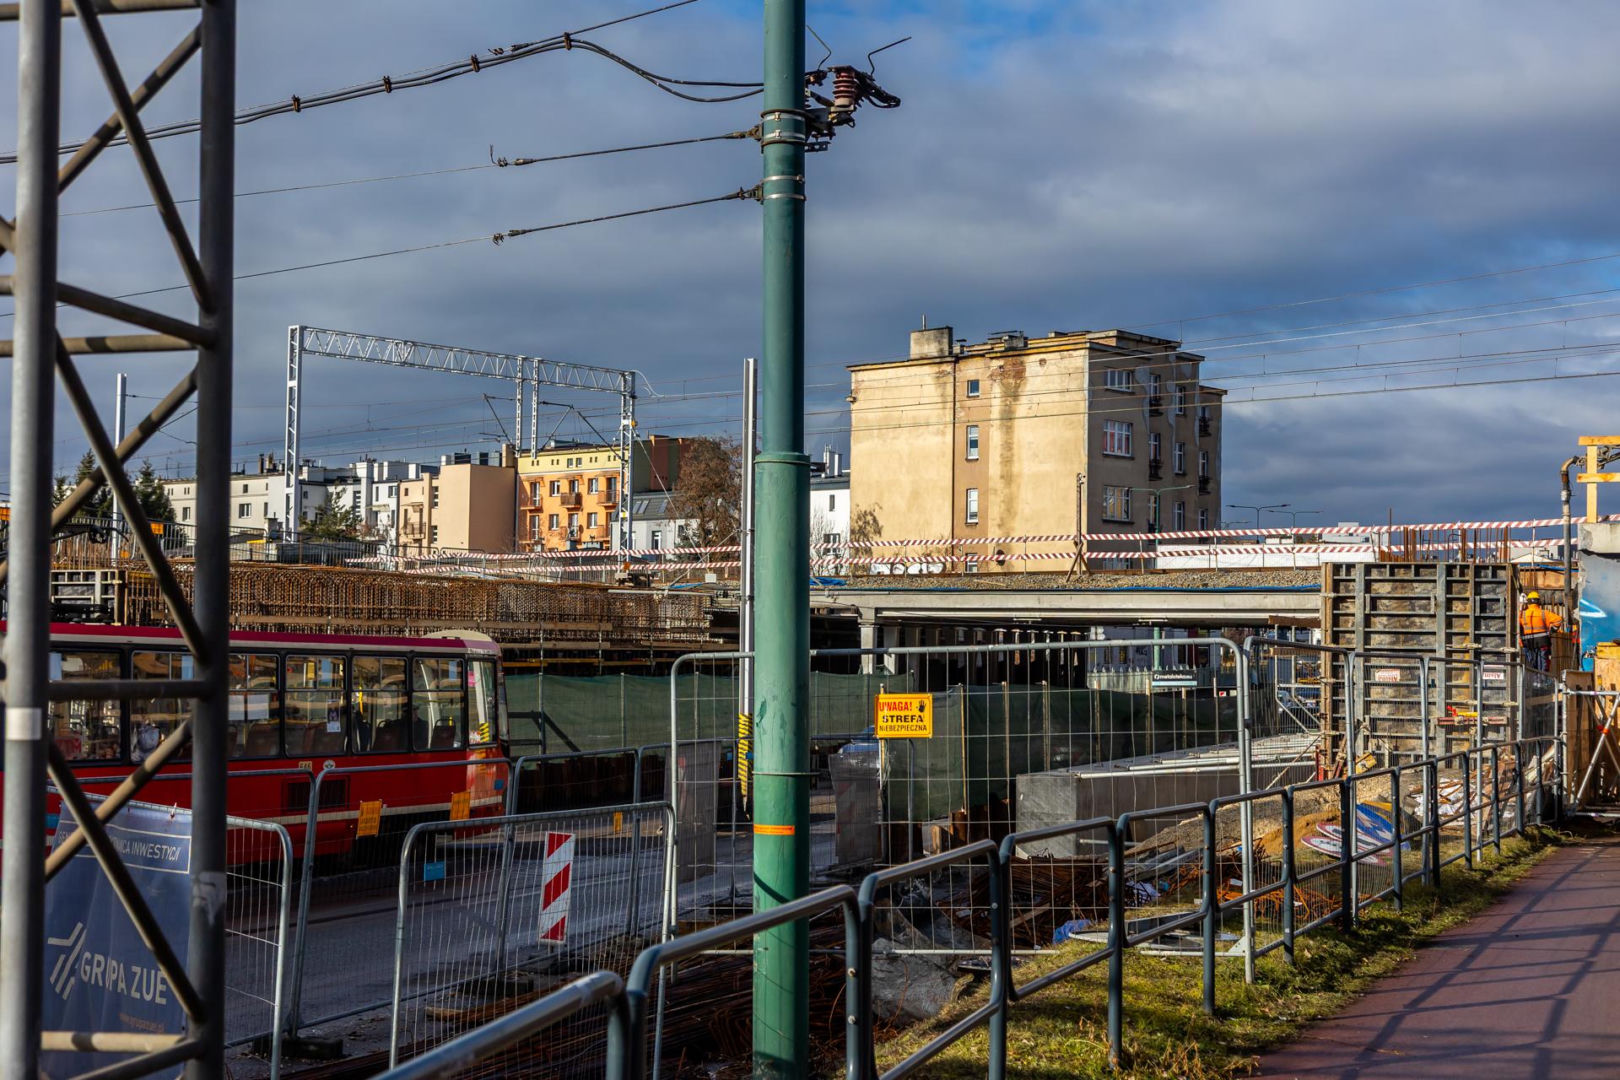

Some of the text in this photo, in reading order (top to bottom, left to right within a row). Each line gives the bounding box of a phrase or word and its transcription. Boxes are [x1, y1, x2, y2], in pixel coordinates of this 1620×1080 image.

[879, 701, 912, 711] UWAGA!
[882, 715, 924, 723] STREFA
[879, 724, 927, 732] NIEBEZPIECZNA
[80, 951, 167, 1005] GRUPA ZUE
